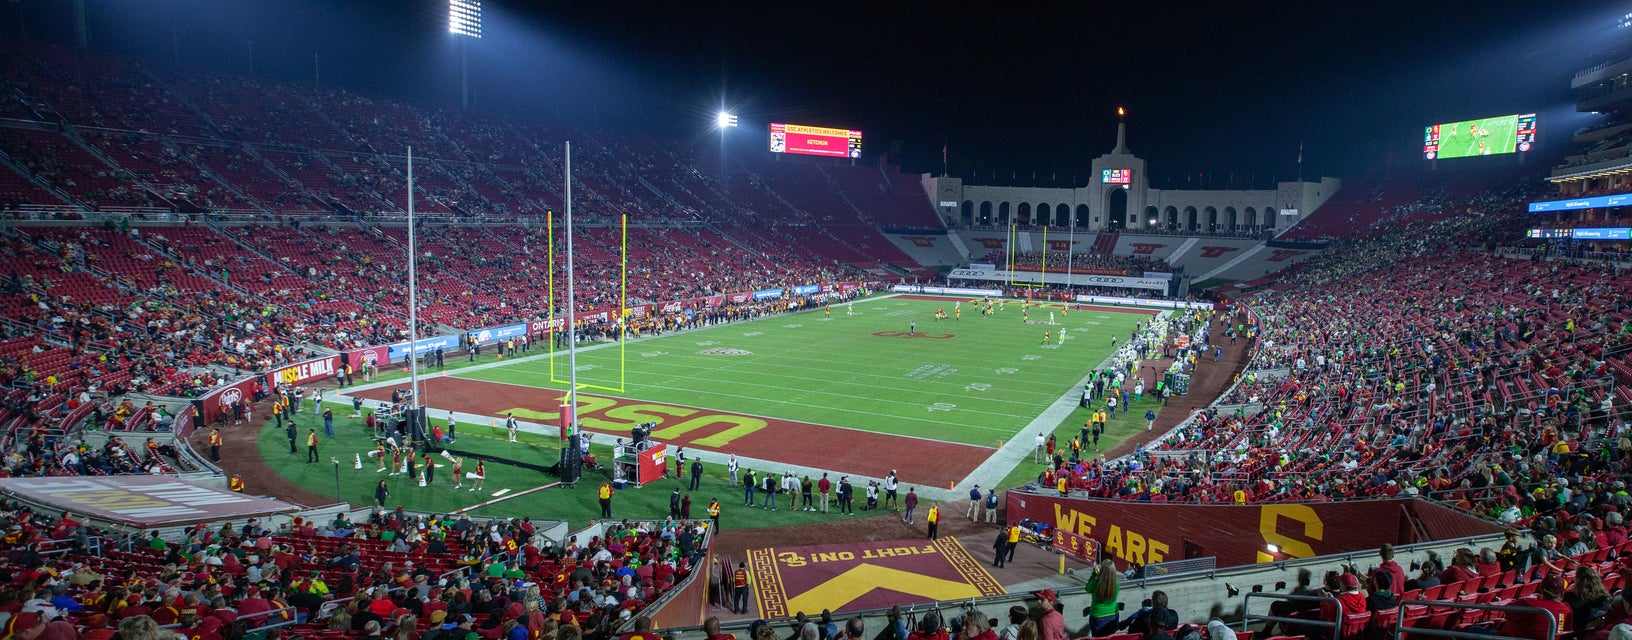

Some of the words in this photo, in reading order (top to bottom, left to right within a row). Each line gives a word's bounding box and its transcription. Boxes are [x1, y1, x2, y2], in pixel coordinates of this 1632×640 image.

[797, 126, 822, 134] ATHLETICS
[273, 364, 309, 387] MUSCLE
[310, 358, 334, 377] MILK
[495, 394, 768, 448] USC
[1054, 503, 1097, 540] WE
[1105, 524, 1169, 568] ARE
[811, 551, 855, 563] ON!
[862, 545, 937, 559] FIGHT
